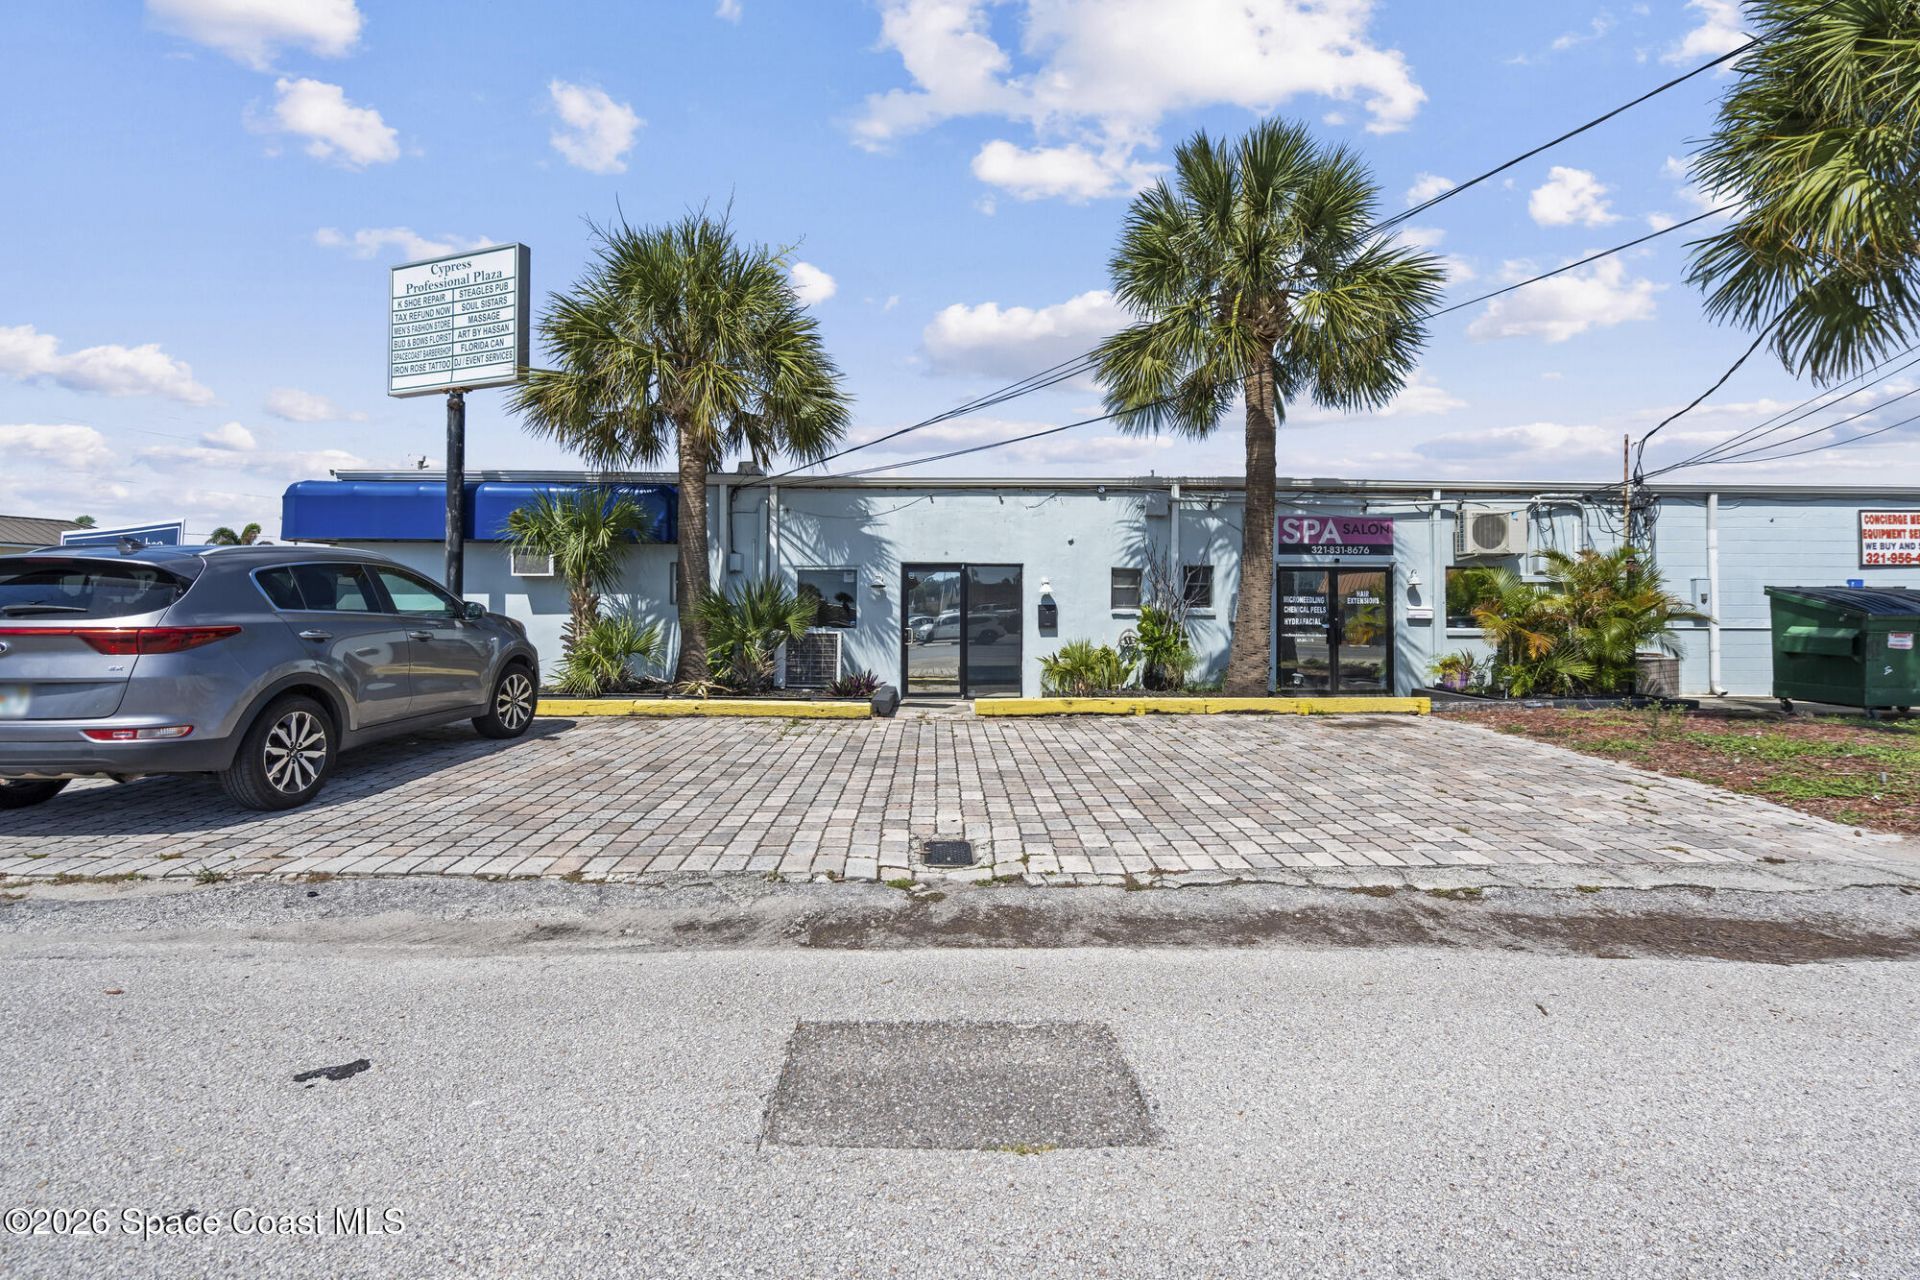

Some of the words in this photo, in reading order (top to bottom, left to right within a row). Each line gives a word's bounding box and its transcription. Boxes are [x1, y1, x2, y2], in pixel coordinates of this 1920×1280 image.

[431, 261, 472, 277] Cypress
[406, 273, 470, 294] Professional
[474, 270, 502, 282] Plaza
[459, 284, 494, 298] STEAGLES
[495, 281, 509, 292] PUB
[404, 297, 421, 308] SHOE
[422, 293, 446, 305] REPAIR
[461, 301, 479, 311] SOUL
[480, 296, 508, 308] SISTARS
[395, 313, 408, 322] TAX
[409, 308, 435, 320] REFUND
[435, 305, 451, 316] NOW
[467, 311, 501, 323] MASSAGE
[394, 325, 411, 335] MEN'S
[411, 321, 434, 333] FASHION
[434, 319, 451, 330] STORE
[457, 329, 471, 339] ART
[472, 327, 481, 337] BY
[482, 323, 510, 335] HASSAN
[394, 339, 406, 349] BUD
[407, 338, 411, 347] &
[412, 335, 429, 347] BOWS
[429, 332, 451, 344] FLORIST
[460, 340, 490, 352] FLORIDA
[490, 338, 504, 348] CAN
[394, 350, 422, 361] SPACECOAST
[422, 346, 452, 358] BARBERSHOP
[454, 358, 461, 367] DJ
[465, 354, 485, 365] EVENT
[485, 350, 513, 363] SERVICES
[394, 364, 409, 374] IRON
[409, 362, 427, 373] ROSE
[427, 359, 451, 371] TATTOO
[1864, 514, 1908, 525] CONCIERGE
[1282, 518, 1344, 544] SPA
[1343, 523, 1390, 535] SALON
[1863, 528, 1907, 539] EQUIPMENT
[1909, 528, 1920, 539] SE
[1311, 545, 1370, 554] 321-831-8676
[1865, 542, 1878, 550] WE
[1880, 542, 1897, 550] BUY
[1899, 542, 1916, 550] AND
[1346, 597, 1380, 605] EXTENSIONS
[1283, 606, 1310, 614] CHEMICAL
[1310, 606, 1327, 614] PEELS
